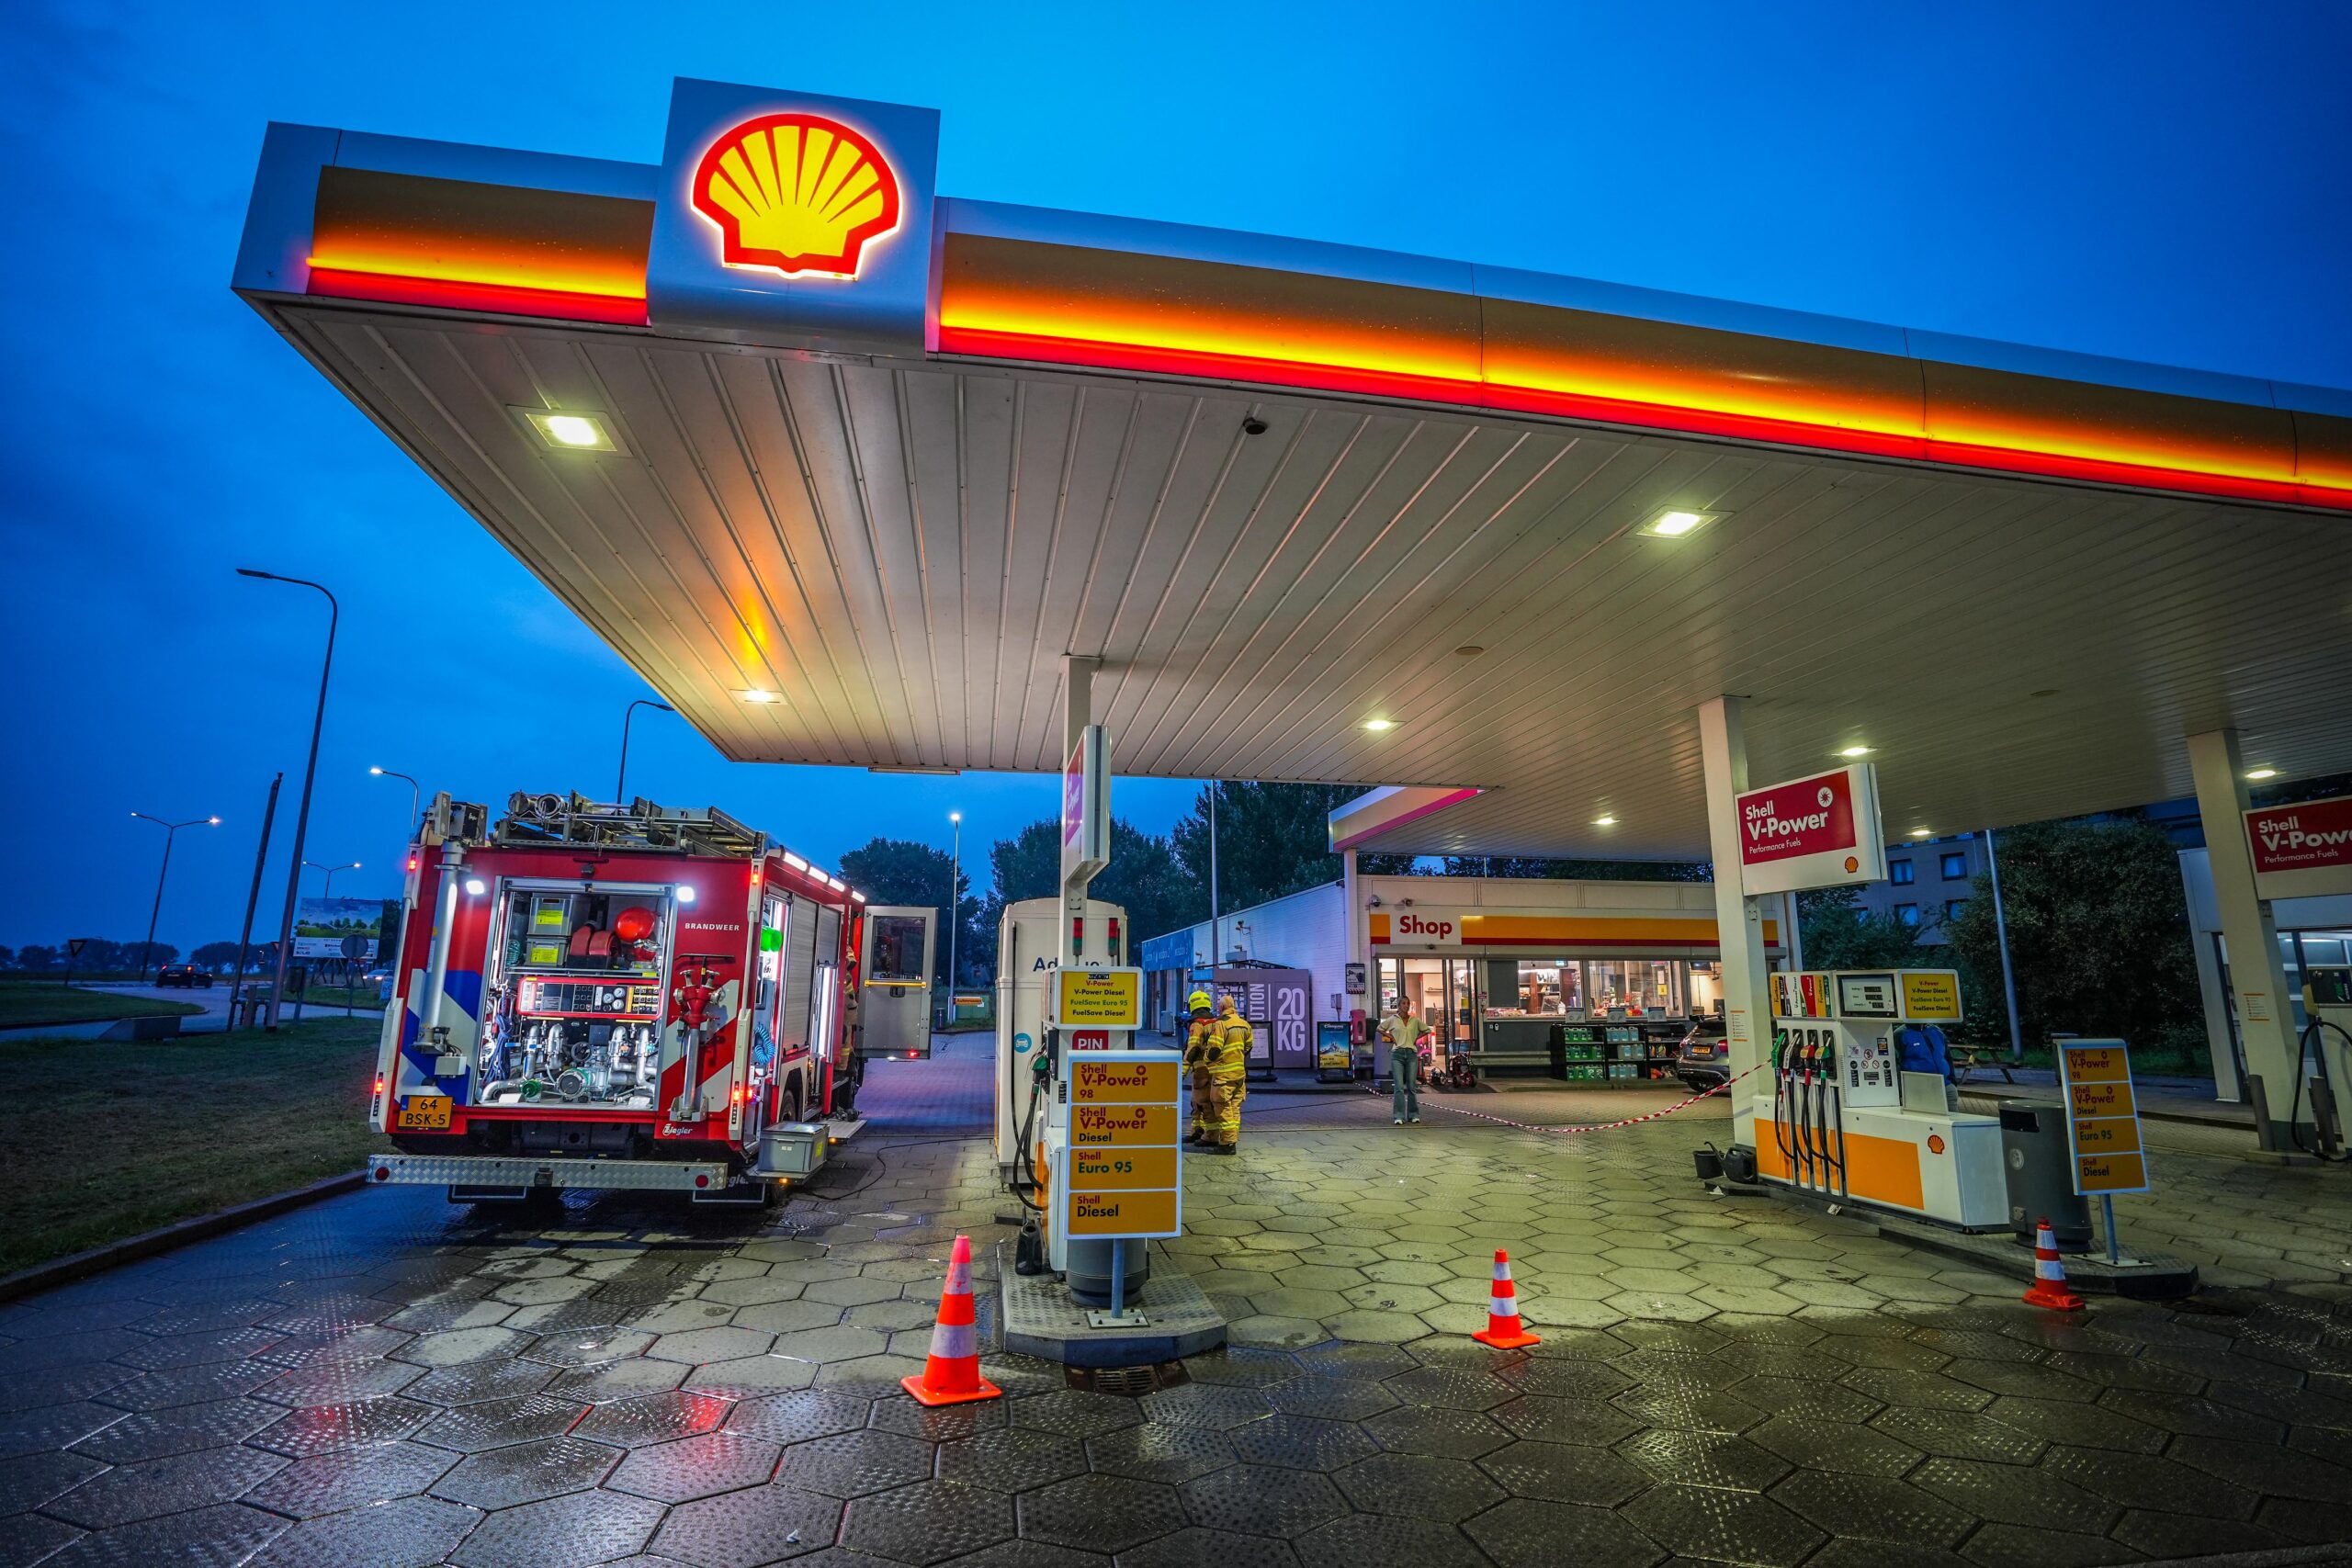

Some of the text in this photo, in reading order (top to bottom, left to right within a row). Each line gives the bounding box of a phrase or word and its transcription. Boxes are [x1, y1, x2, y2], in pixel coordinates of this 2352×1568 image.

[1746, 800, 1774, 820] Shell
[1747, 812, 1828, 840] V-Power
[2258, 816, 2299, 834] Shell
[1748, 837, 1802, 854] Performance Fuels
[2264, 849, 2339, 863] Performance Fuels
[684, 922, 740, 931] BRANDWEER
[1399, 915, 1453, 940] Shop
[1250, 984, 1264, 1021] UTION
[1278, 987, 1305, 1020] 20
[1278, 1021, 1305, 1052] KG
[1079, 1038, 1102, 1050] PIN
[2069, 1050, 2085, 1058] Shell
[1080, 1064, 1107, 1073] Shell
[2071, 1058, 2109, 1068] V-Power
[1081, 1074, 1148, 1086] V-Power
[1080, 1089, 1093, 1099] 98
[2075, 1086, 2090, 1094] Shell
[420, 1099, 437, 1110] 64
[2075, 1094, 2115, 1104] V-Power
[1080, 1107, 1106, 1117] Shell
[2076, 1106, 2097, 1115] Diesel
[405, 1113, 446, 1124] BSK-5
[1080, 1117, 1148, 1129] V-Power
[662, 1123, 693, 1135] Ziegler
[2078, 1122, 2093, 1131] Shell
[1079, 1133, 1112, 1142] Diesel
[2080, 1130, 2112, 1141] Euro 95
[1078, 1152, 1101, 1160] Shell
[1078, 1161, 1132, 1173] Euro 95
[2082, 1157, 2097, 1167] Shell
[2083, 1165, 2109, 1177] Diesel
[1077, 1196, 1100, 1204] Shell
[1077, 1204, 1119, 1217] Diesel
